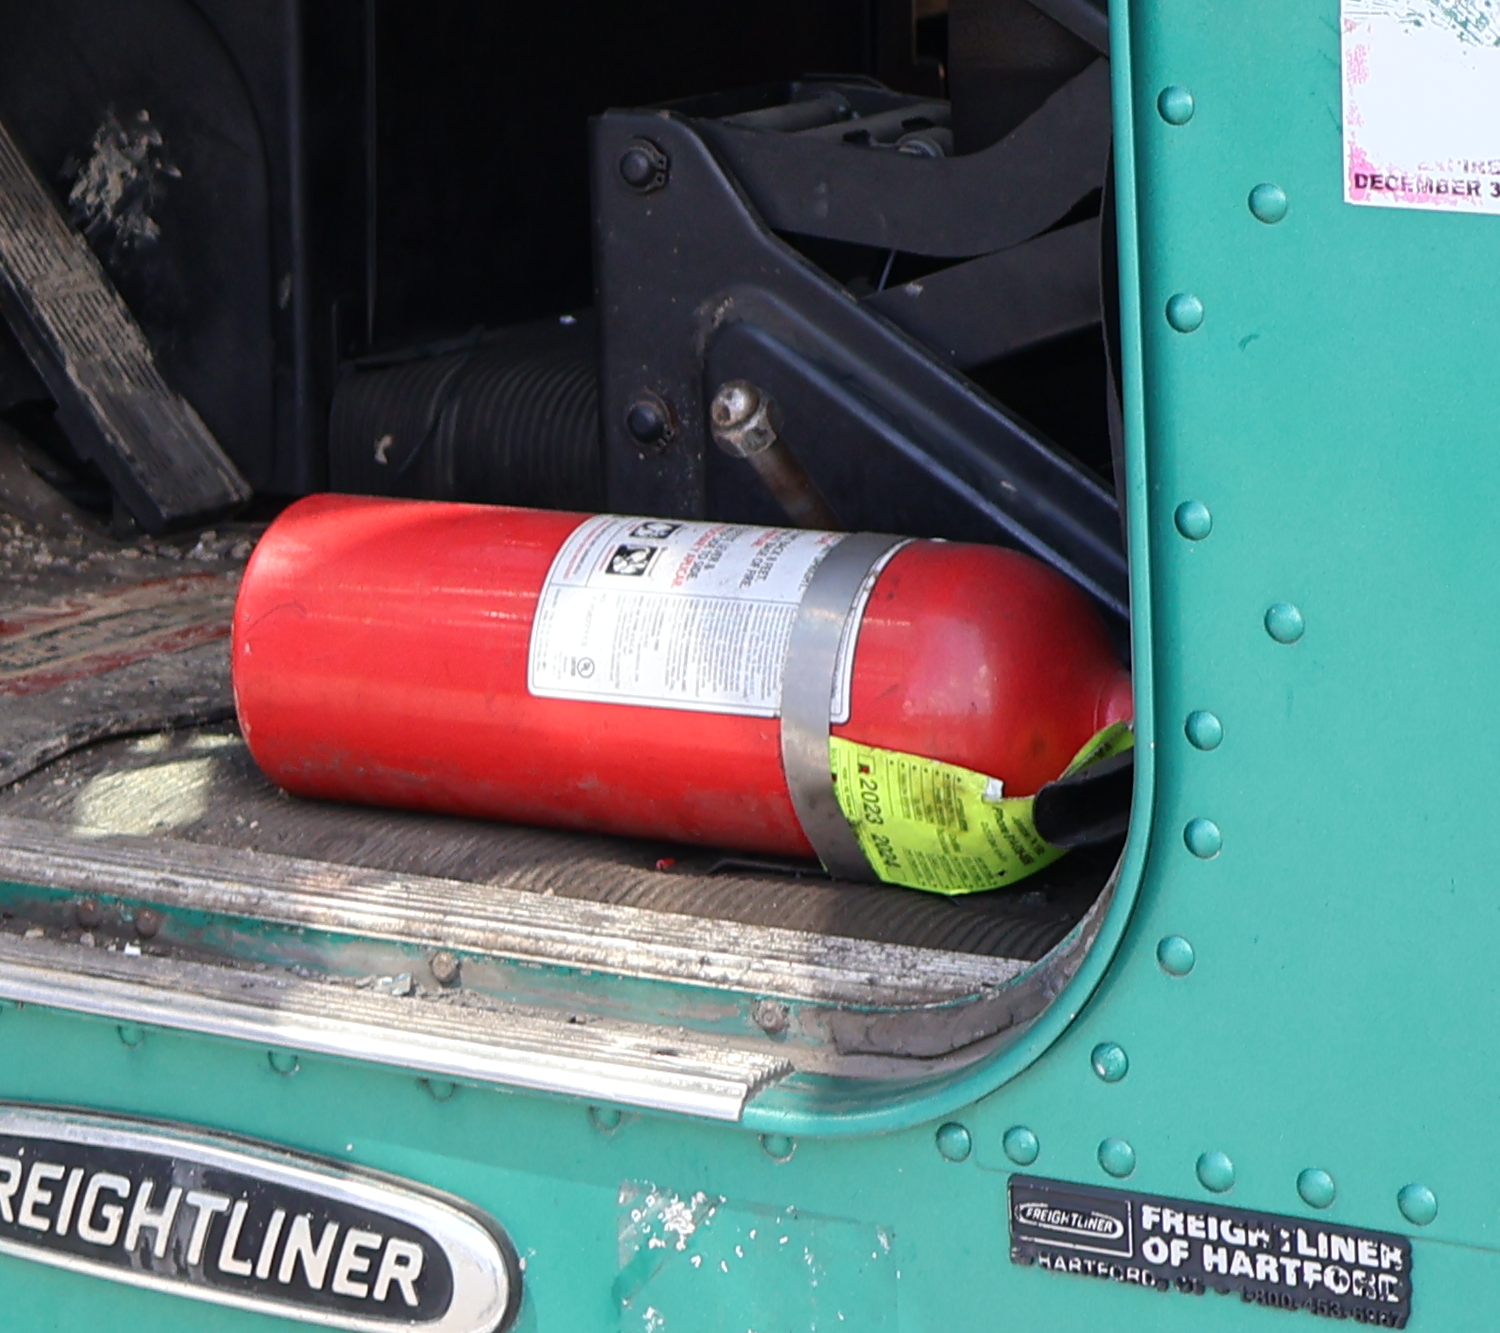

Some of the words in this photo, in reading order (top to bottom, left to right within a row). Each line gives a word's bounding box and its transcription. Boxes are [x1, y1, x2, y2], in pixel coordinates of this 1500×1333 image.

[1353, 172, 1482, 197] DECEMBER
[860, 778, 885, 825] 2023
[870, 833, 901, 869] 2024
[1024, 1205, 1117, 1232] FREIGHTLINER
[1141, 1239, 1189, 1267] OF
